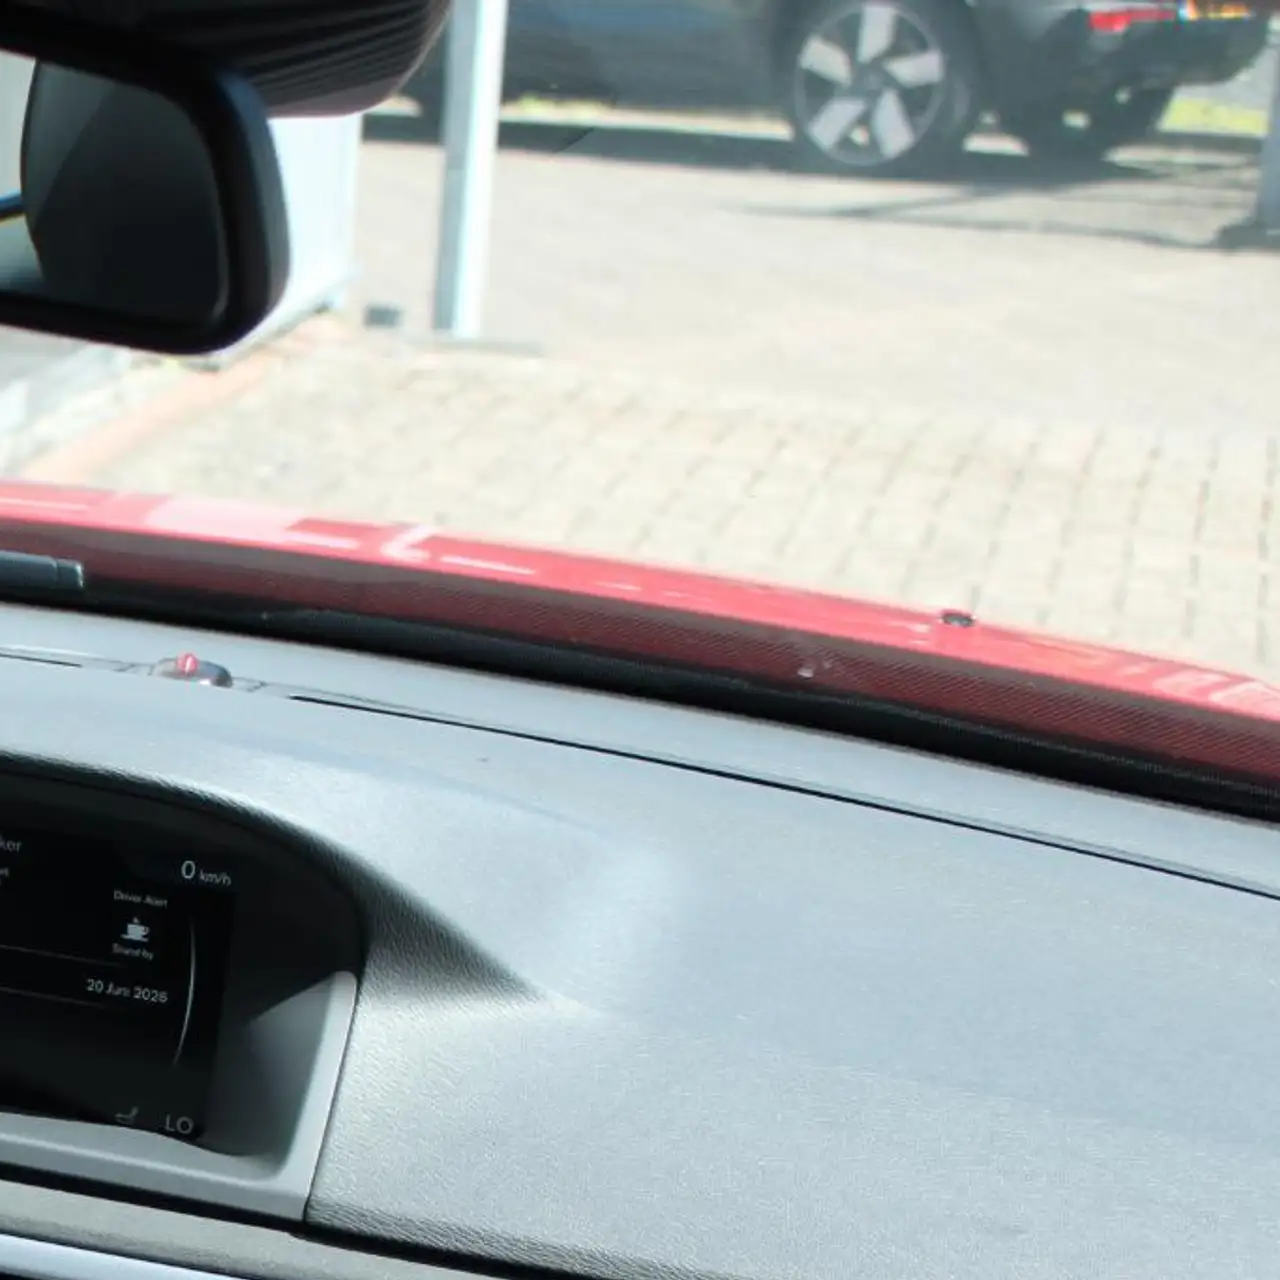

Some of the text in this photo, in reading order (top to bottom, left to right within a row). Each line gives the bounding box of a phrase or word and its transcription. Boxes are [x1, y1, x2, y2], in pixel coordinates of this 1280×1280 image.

[181, 859, 232, 887] 0 km/h
[85, 976, 105, 994] 20
[165, 1112, 194, 1136] LO
